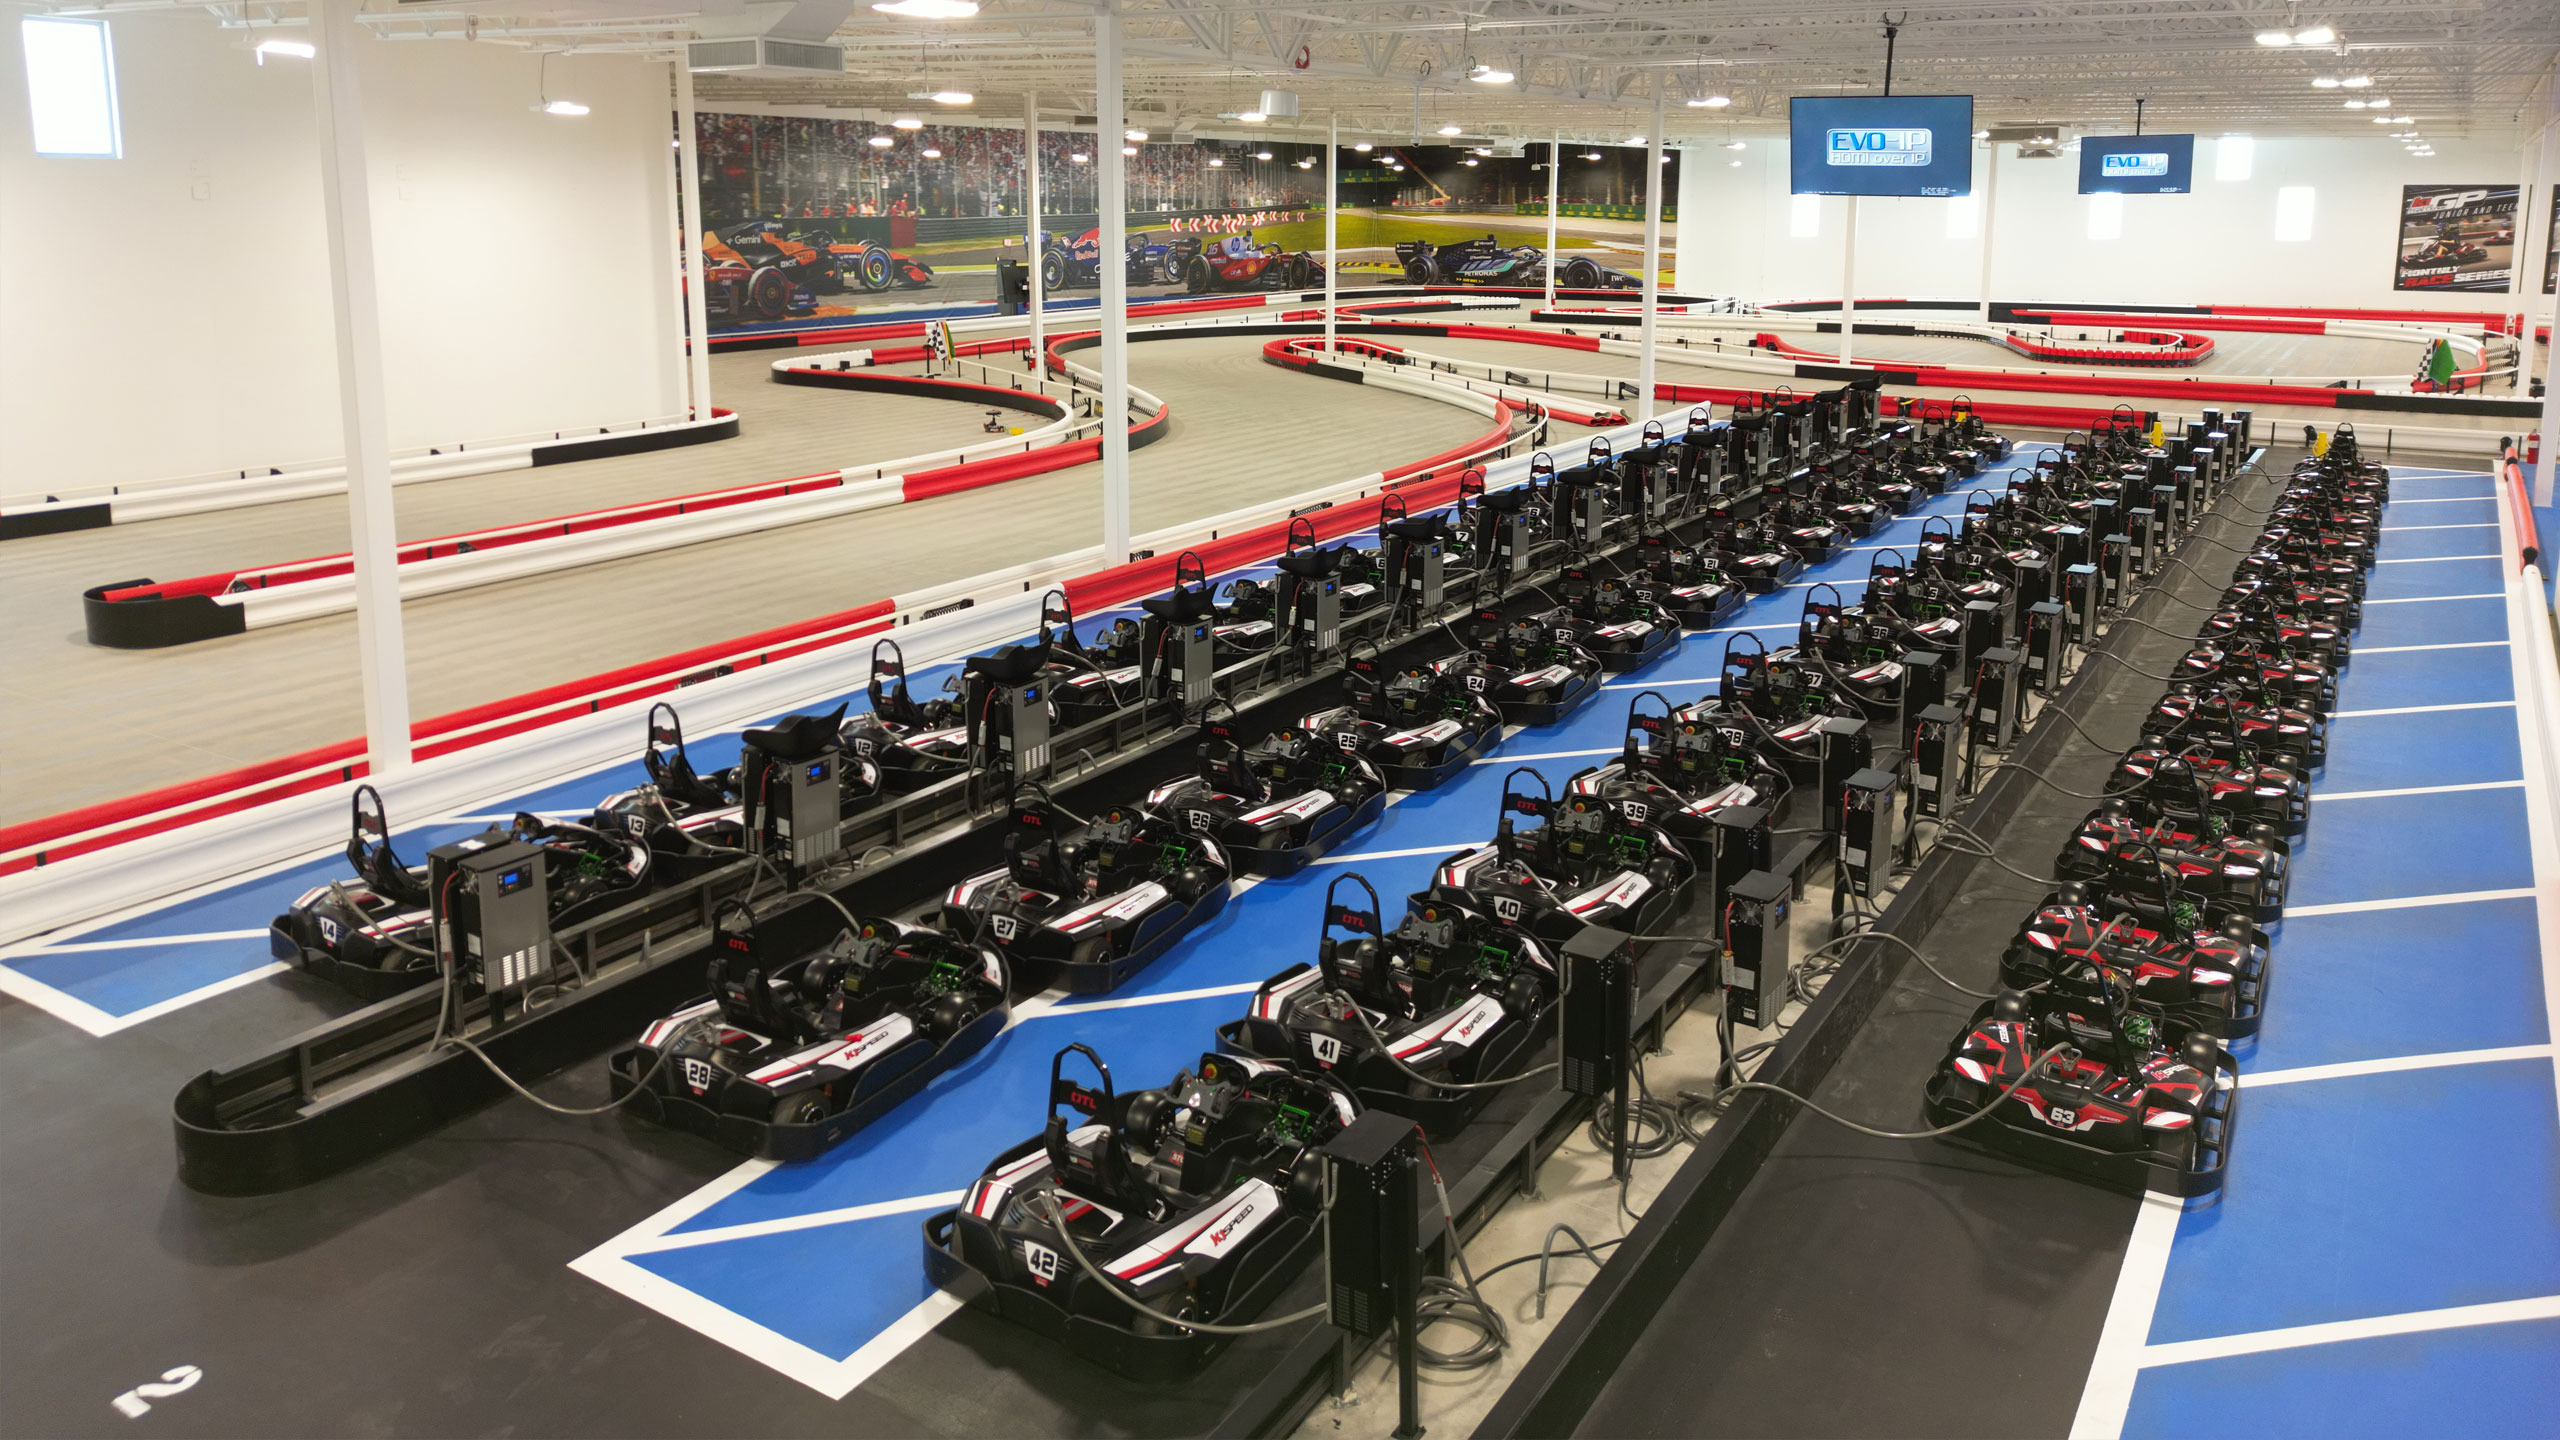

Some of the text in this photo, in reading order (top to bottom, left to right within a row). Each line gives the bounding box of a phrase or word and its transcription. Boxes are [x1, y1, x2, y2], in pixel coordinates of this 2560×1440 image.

[1832, 132, 1926, 150] EVO-IP
[1832, 152, 1926, 164] HDMI over IP
[2432, 190, 2488, 209] GP
[2434, 208, 2468, 219] JUNIOR
[2473, 205, 2491, 214] AND
[735, 235, 760, 244] Gemini
[2401, 266, 2461, 277] MONTHLY
[2404, 274, 2454, 288] RACE
[1707, 559, 1717, 568] 21
[1639, 592, 1651, 600] 22
[1558, 631, 1572, 640] 23
[1874, 627, 1887, 637] 36
[1470, 678, 1483, 690] 24
[858, 742, 870, 751] 12
[1341, 735, 1356, 748] 25
[1626, 803, 1645, 819] 39
[632, 818, 643, 832] 13
[1192, 813, 1209, 828] 26
[1498, 900, 1518, 917] 40
[323, 921, 334, 939] 14
[997, 919, 1014, 936] 27
[2128, 1034, 2144, 1044] GO
[1318, 1039, 1334, 1058] 41
[690, 1064, 708, 1084] 28
[2050, 1107, 2075, 1124] 63
[1030, 1249, 1055, 1275] 42
[111, 1364, 202, 1419] 2
